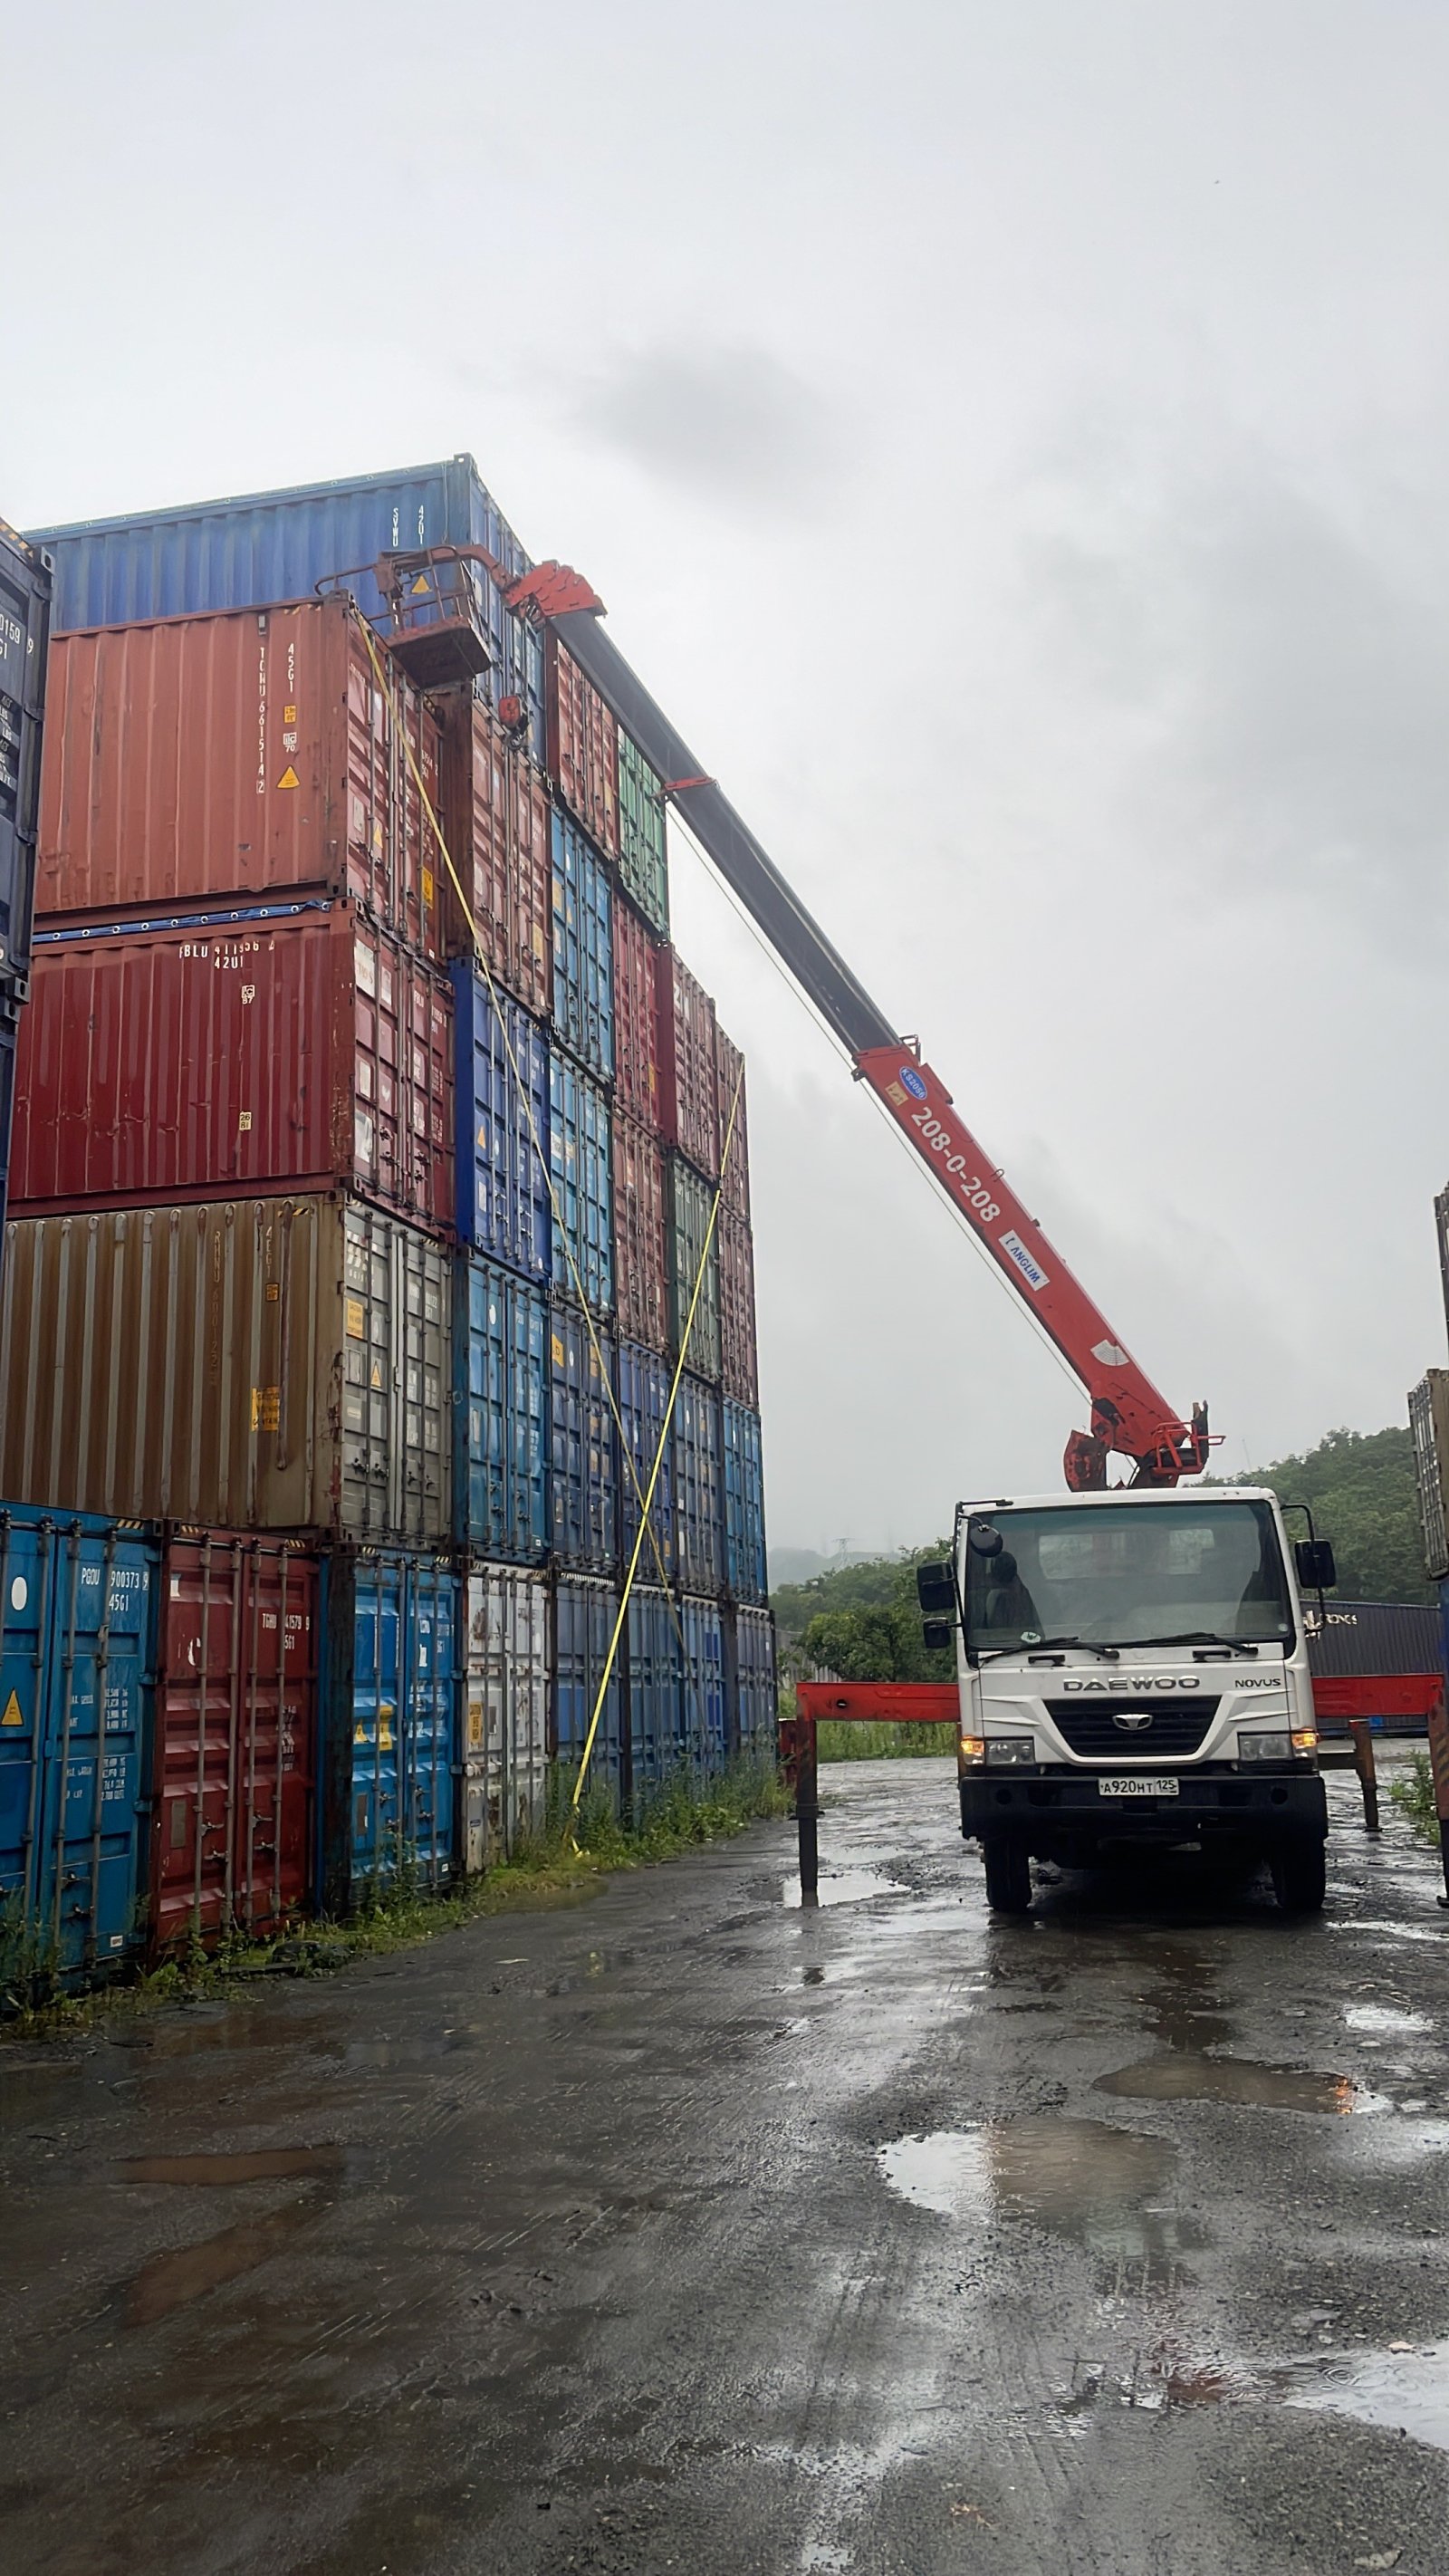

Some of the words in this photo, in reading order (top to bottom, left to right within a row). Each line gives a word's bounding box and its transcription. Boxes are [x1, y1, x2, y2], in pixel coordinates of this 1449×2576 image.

[285, 745, 296, 754] 70
[215, 956, 245, 969] 42U1
[901, 1068, 926, 1099] KS2056
[911, 1106, 1001, 1223] 208-0-208
[110, 1570, 140, 1589] 900373
[109, 1593, 129, 1611] 45G1
[1063, 1675, 1200, 1691] DAEWOO
[1234, 1677, 1281, 1688] NOVUS
[1156, 1779, 1176, 1790] 125
